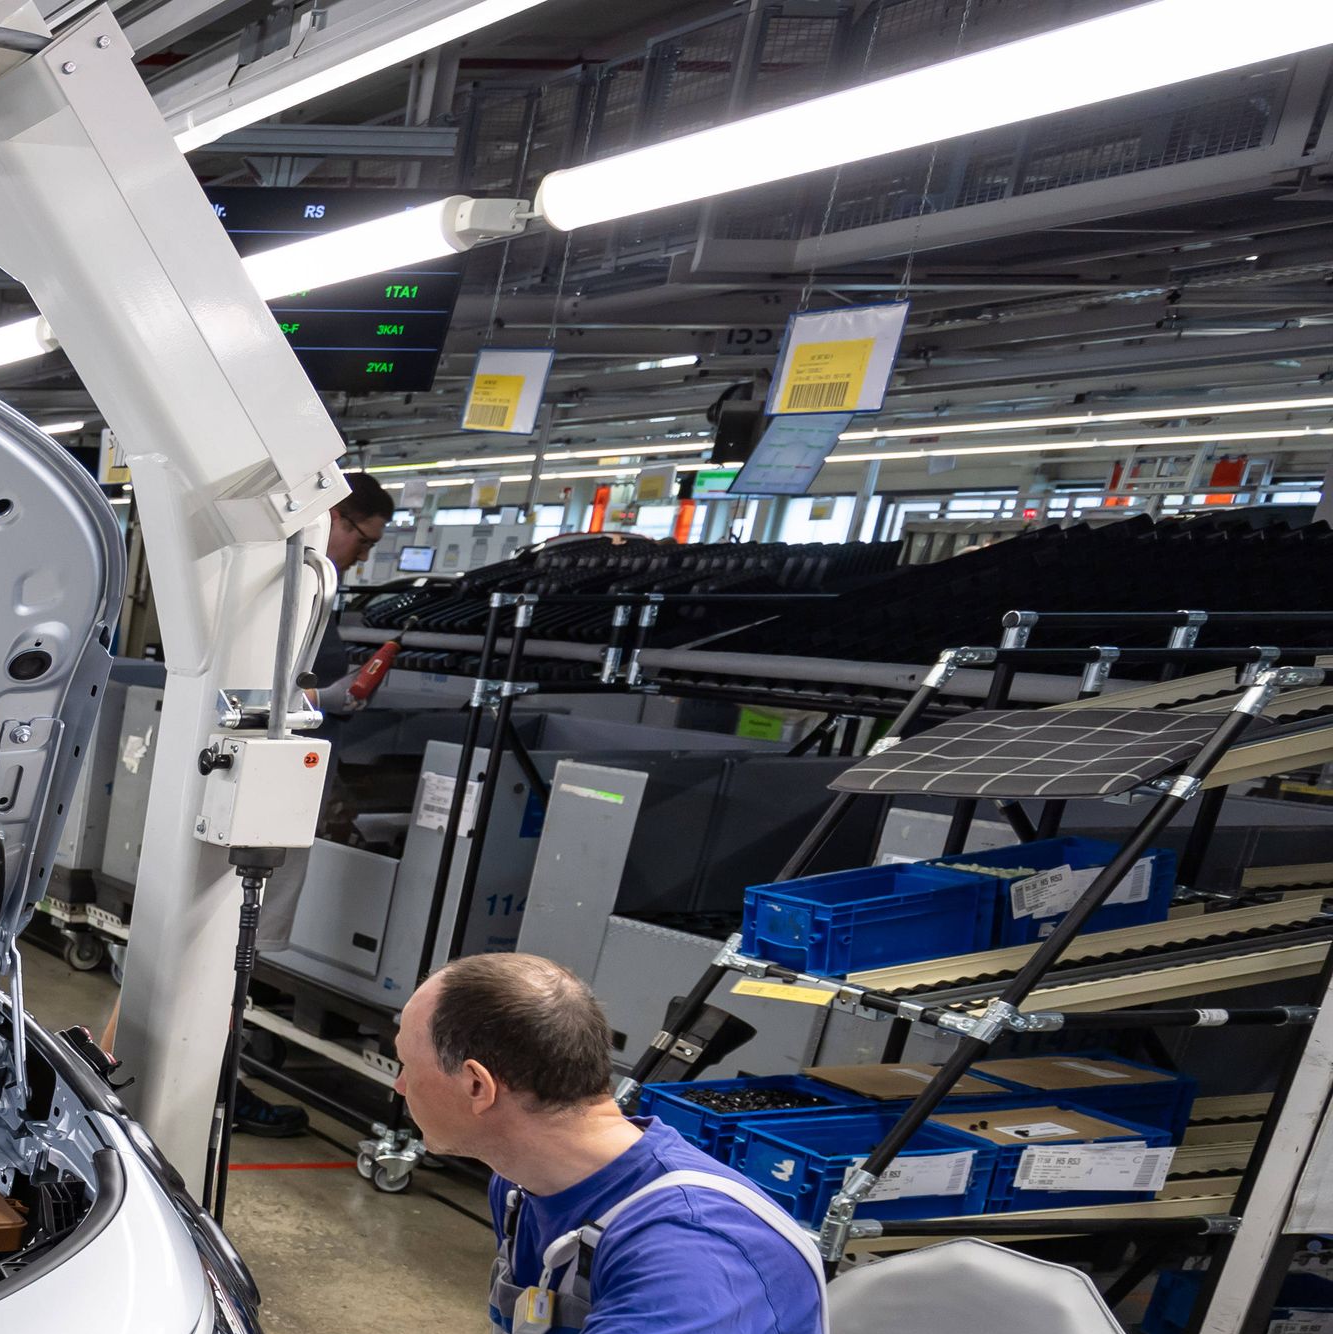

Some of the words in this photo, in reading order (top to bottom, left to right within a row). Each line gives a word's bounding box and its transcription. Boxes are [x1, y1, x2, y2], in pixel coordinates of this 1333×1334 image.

[304, 205, 325, 218] RS
[385, 285, 418, 298] 1TA1
[377, 325, 404, 335] 3KA1
[366, 362, 393, 373] 2YA1
